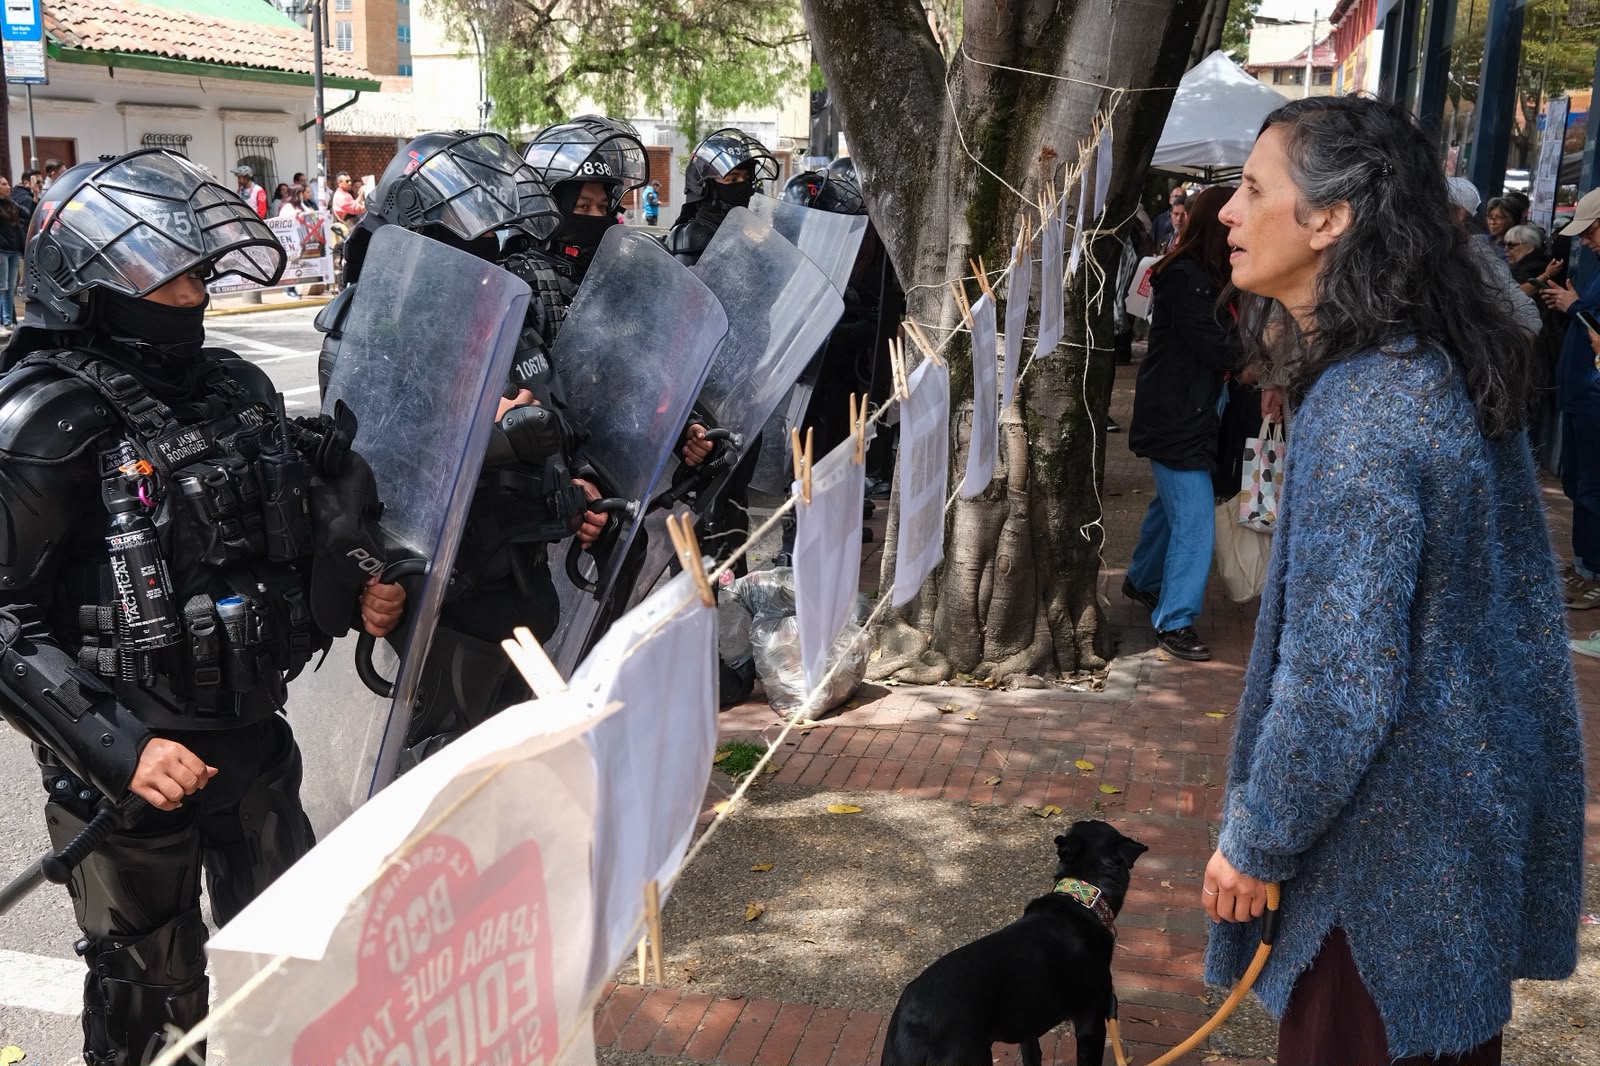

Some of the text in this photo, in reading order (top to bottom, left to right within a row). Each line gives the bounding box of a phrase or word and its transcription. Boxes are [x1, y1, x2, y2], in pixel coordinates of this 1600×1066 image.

[178, 429, 204, 447] JASMIN
[166, 440, 209, 463] RODRIGUEZ
[117, 554, 141, 621] TACTICAL
